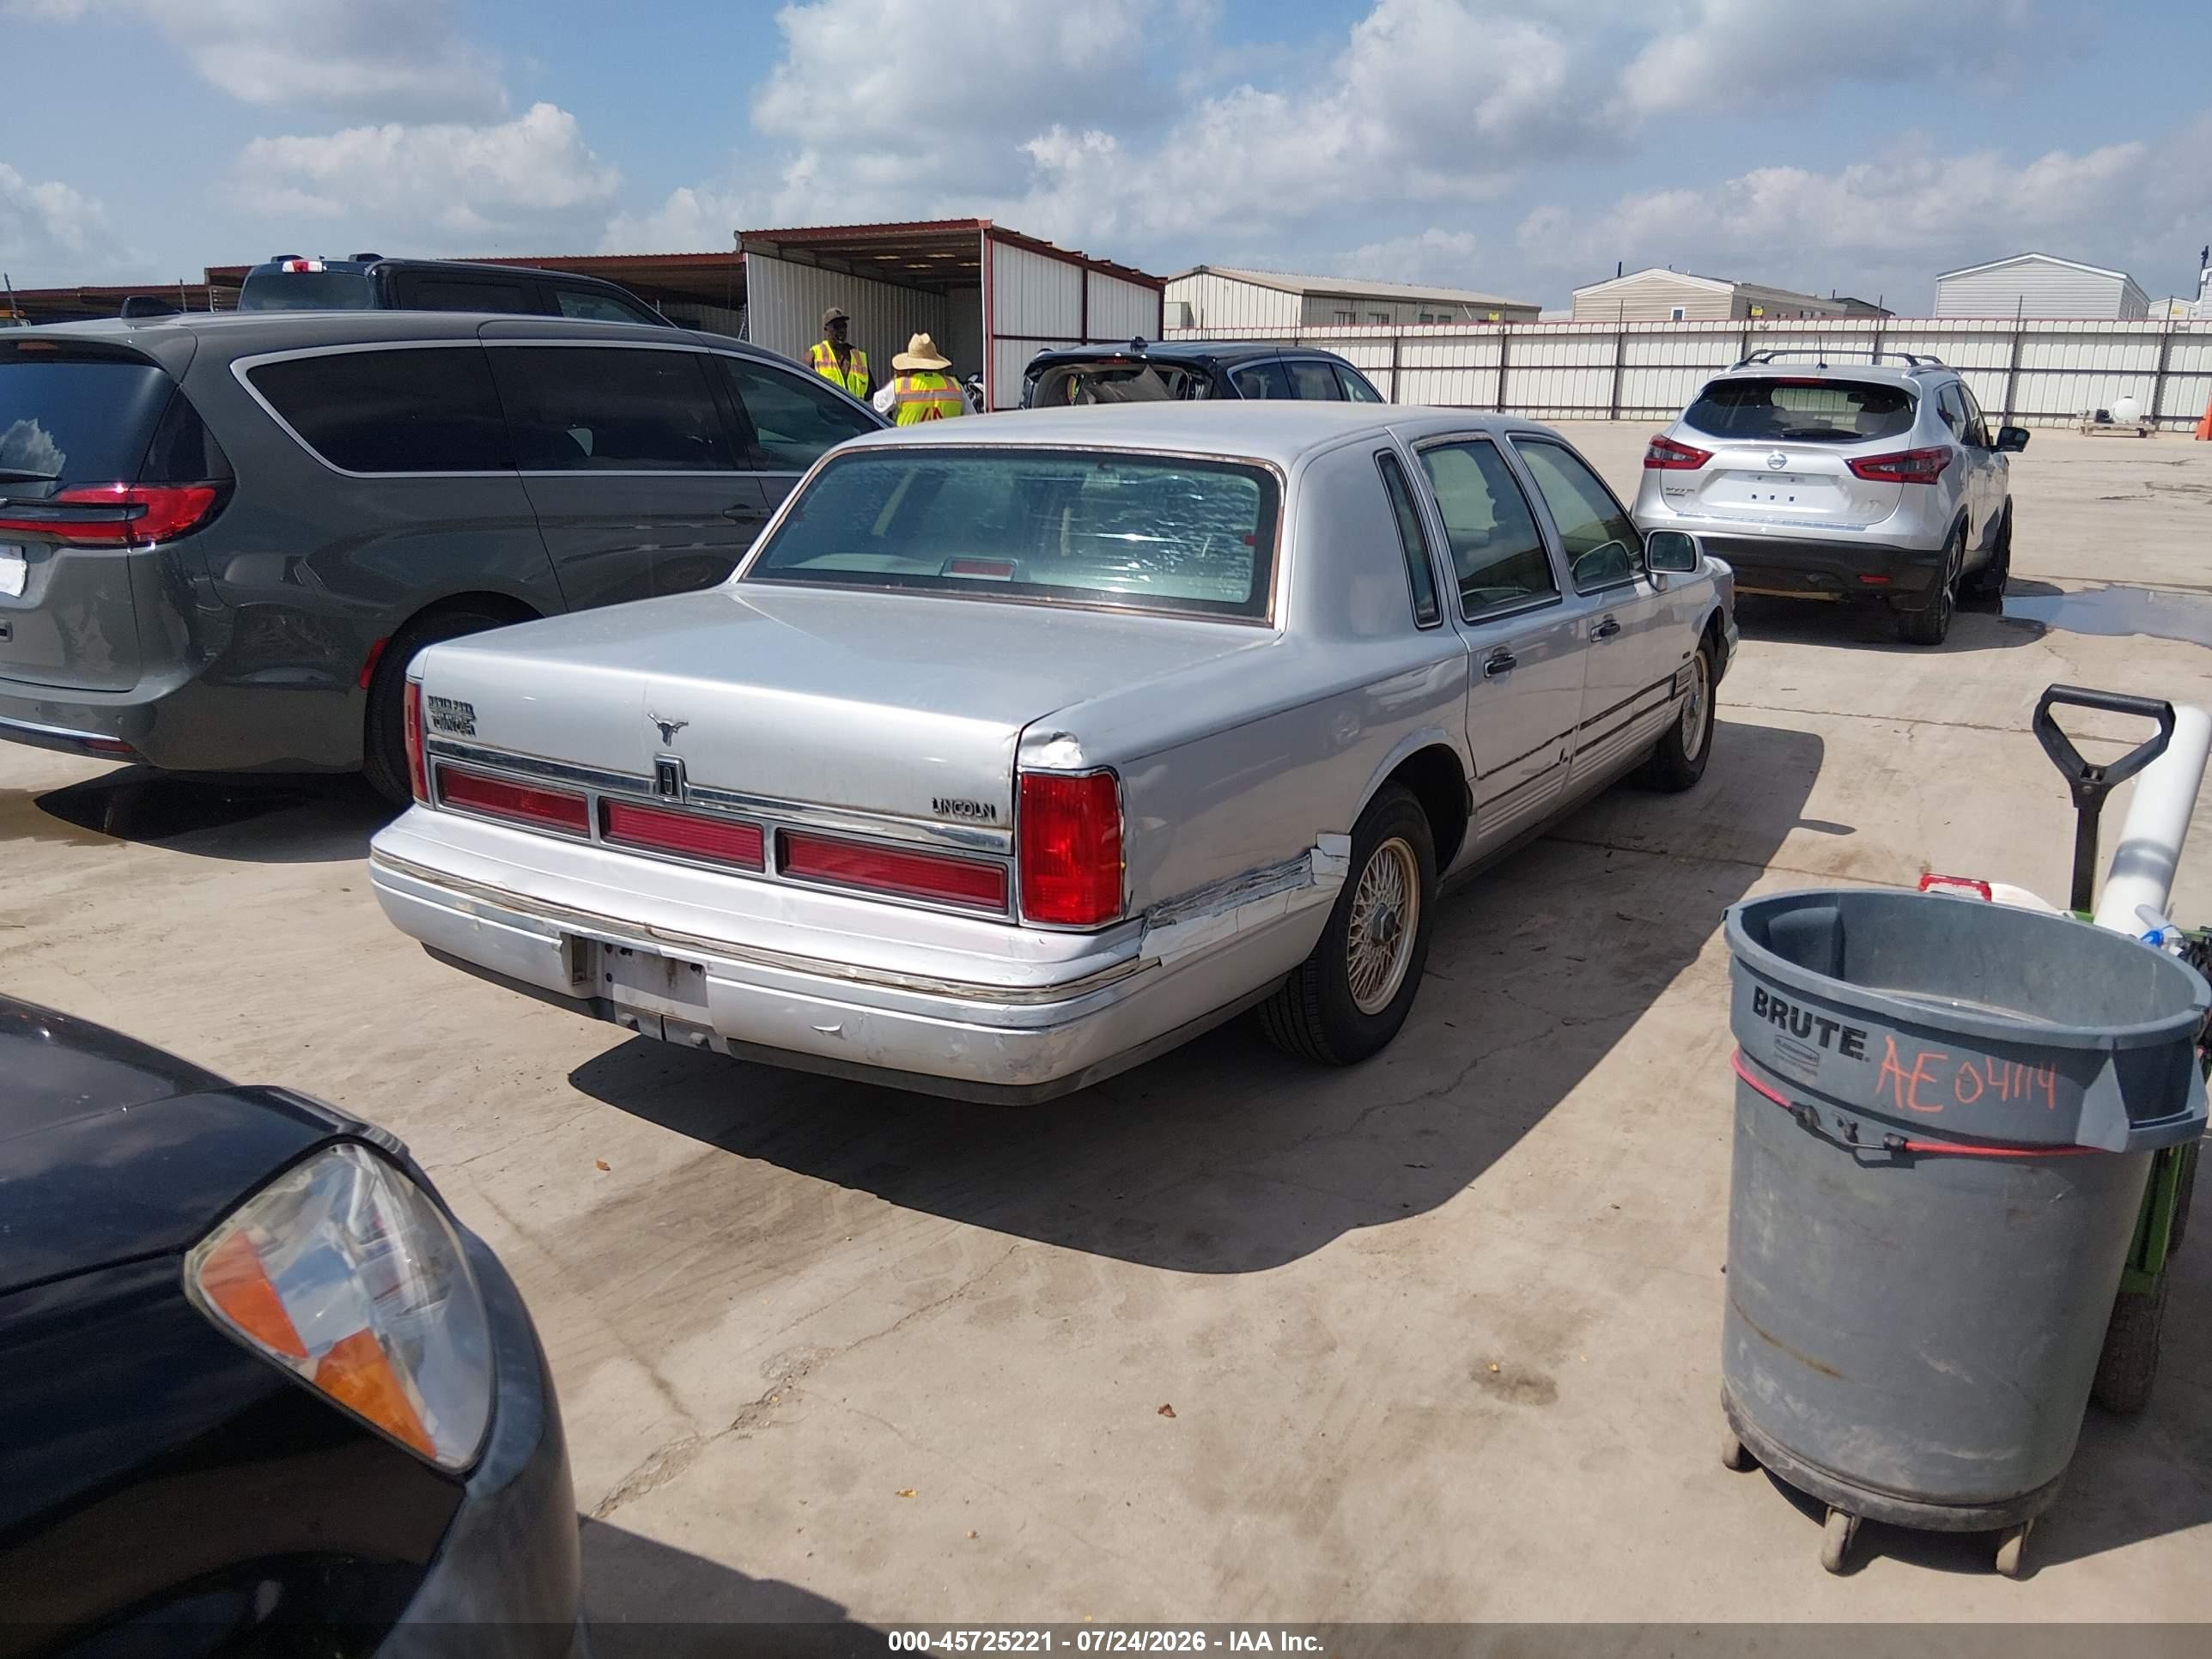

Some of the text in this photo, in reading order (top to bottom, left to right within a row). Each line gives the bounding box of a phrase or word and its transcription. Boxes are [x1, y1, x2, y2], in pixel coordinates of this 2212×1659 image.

[932, 797, 996, 818] LINCOLN
[1753, 986, 1868, 1061] BRUTE
[1875, 1035, 1948, 1113] AE
